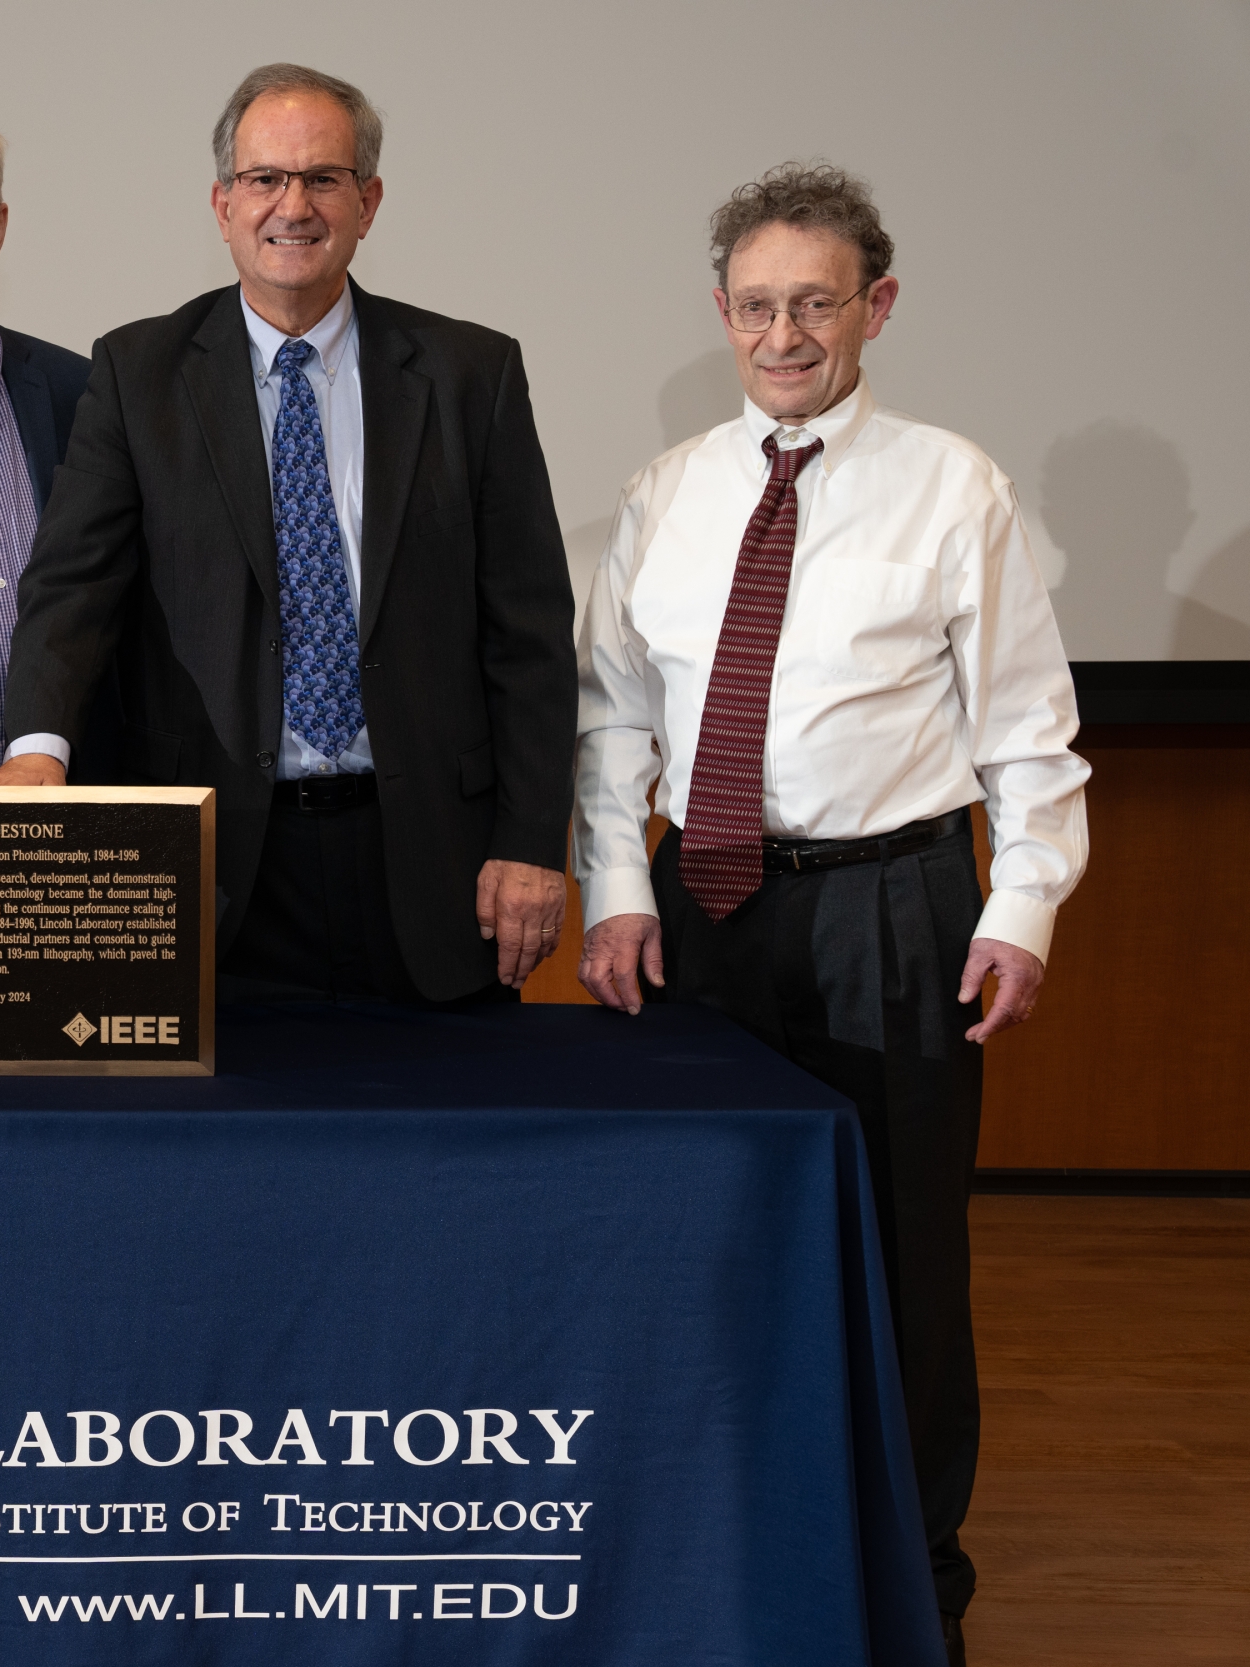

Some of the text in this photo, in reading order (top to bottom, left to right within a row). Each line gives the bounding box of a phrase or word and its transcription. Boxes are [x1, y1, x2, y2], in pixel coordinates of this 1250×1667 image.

[12, 849, 90, 863] Photolithography,
[30, 872, 90, 886] development,
[92, 873, 110, 883] and
[113, 873, 176, 883] demonstration
[49, 888, 84, 898] became
[88, 888, 103, 898] the
[107, 888, 149, 898] dominant
[153, 888, 176, 901] high-
[4, 903, 18, 913] the
[21, 903, 70, 914] continuous
[73, 903, 130, 916] performance
[133, 903, 164, 916] scaling
[167, 903, 176, 914] of
[39, 918, 73, 929] Lincoln
[75, 918, 124, 931] Laboratory
[126, 918, 176, 929] established
[33, 934, 70, 946] partners
[73, 933, 90, 944] and
[94, 933, 135, 944] consortia
[138, 935, 148, 944] to
[151, 933, 176, 947] guide
[8, 948, 39, 959] 193-nm
[44, 948, 94, 962] lithography,
[98, 948, 126, 959] which
[130, 948, 157, 961] paved
[161, 948, 175, 959] the
[8, 992, 30, 1002] 2024
[100, 1016, 179, 1045] IEEE
[18, 1583, 578, 1622] www.LL.MIT.EDU
